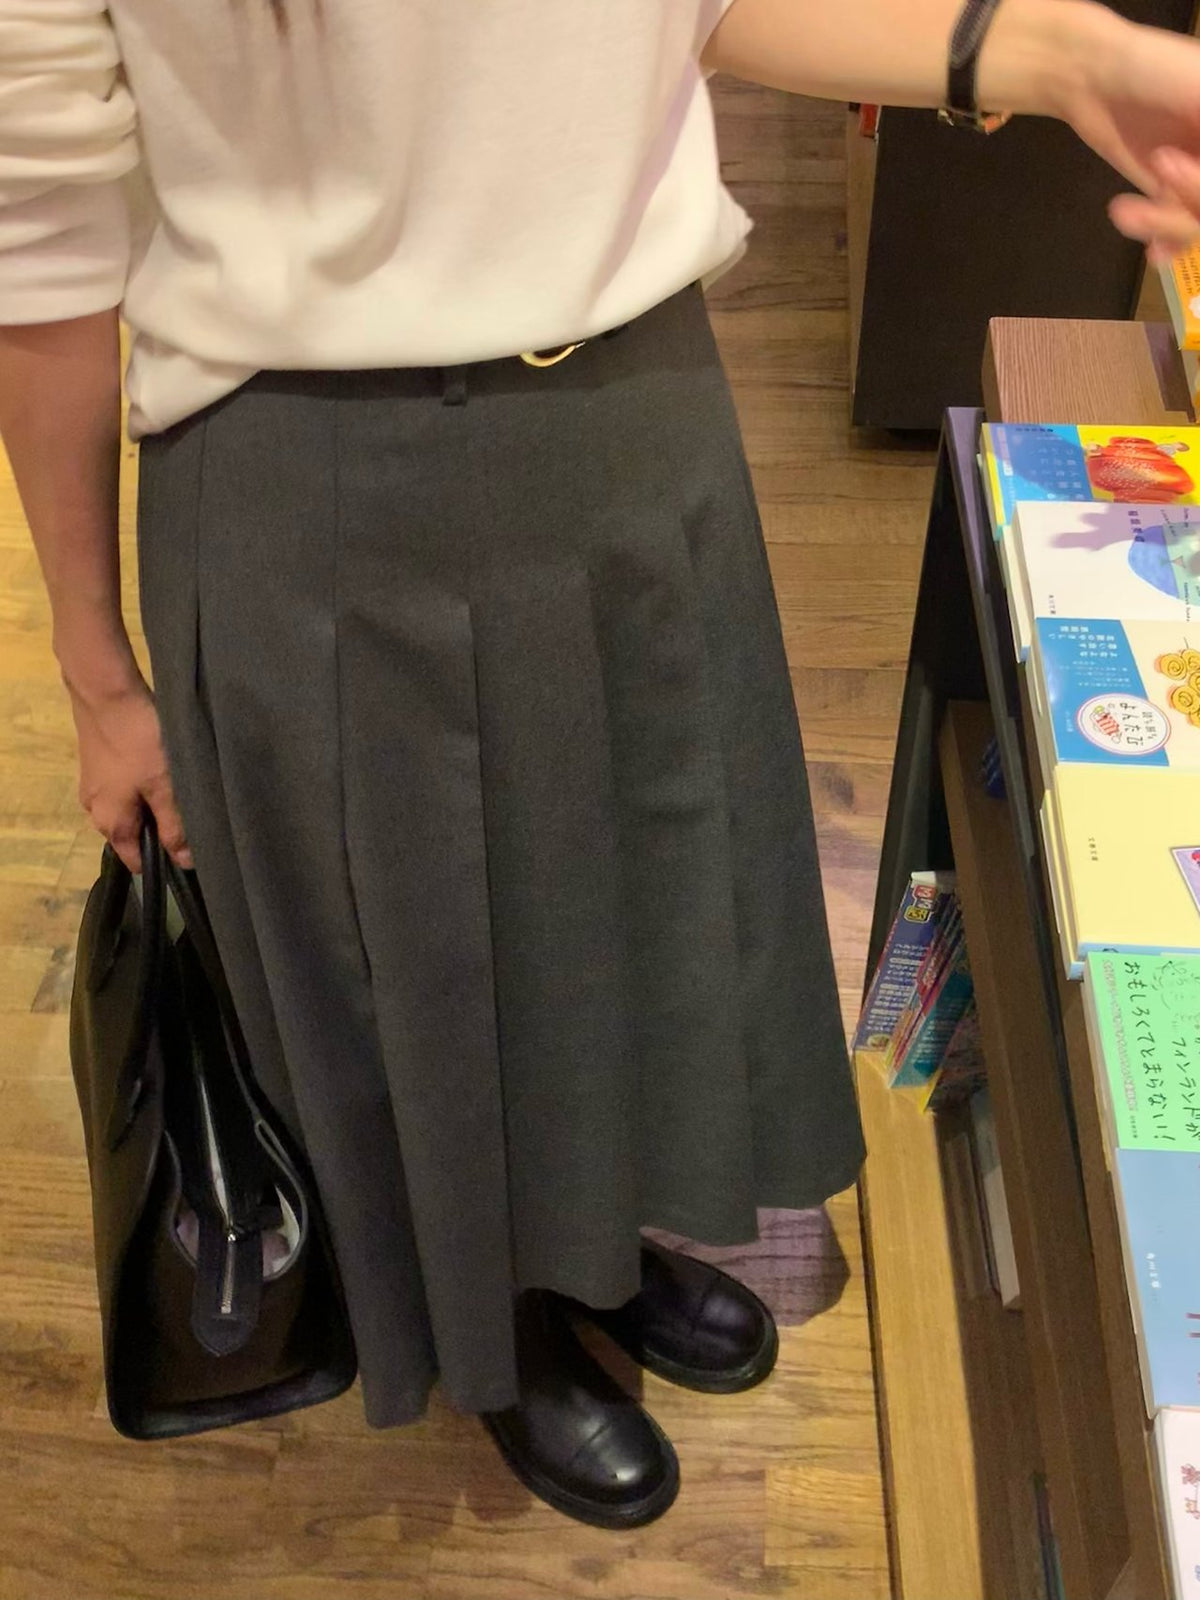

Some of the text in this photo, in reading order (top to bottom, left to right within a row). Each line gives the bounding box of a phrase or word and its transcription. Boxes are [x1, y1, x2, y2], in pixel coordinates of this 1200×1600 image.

[1119, 702, 1144, 746] よんたび
[1124, 961, 1176, 1141] おもしろくてとまらない!
